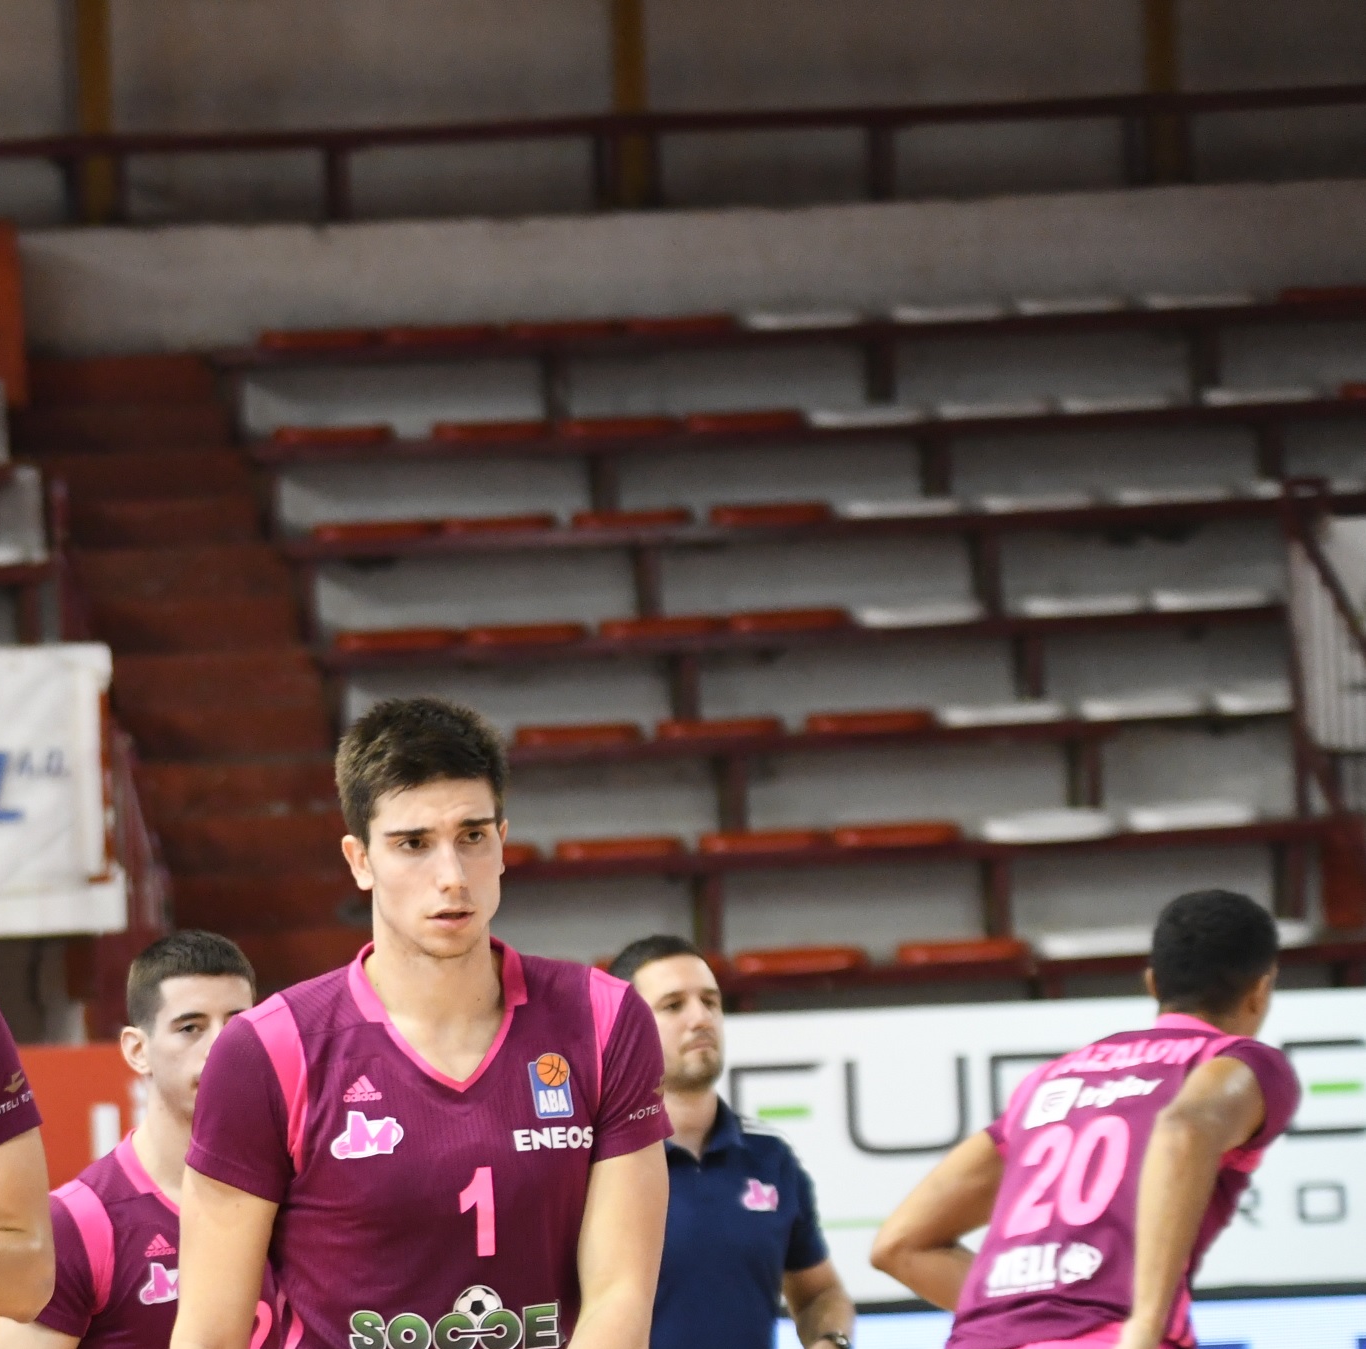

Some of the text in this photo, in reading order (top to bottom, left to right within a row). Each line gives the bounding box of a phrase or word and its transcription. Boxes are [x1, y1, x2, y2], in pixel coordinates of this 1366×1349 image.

[343, 1089, 383, 1103] adidas
[537, 1089, 570, 1113] ABA
[513, 1126, 594, 1152] ENEOS
[1004, 1114, 1130, 1240] 20
[459, 1166, 497, 1257] 1
